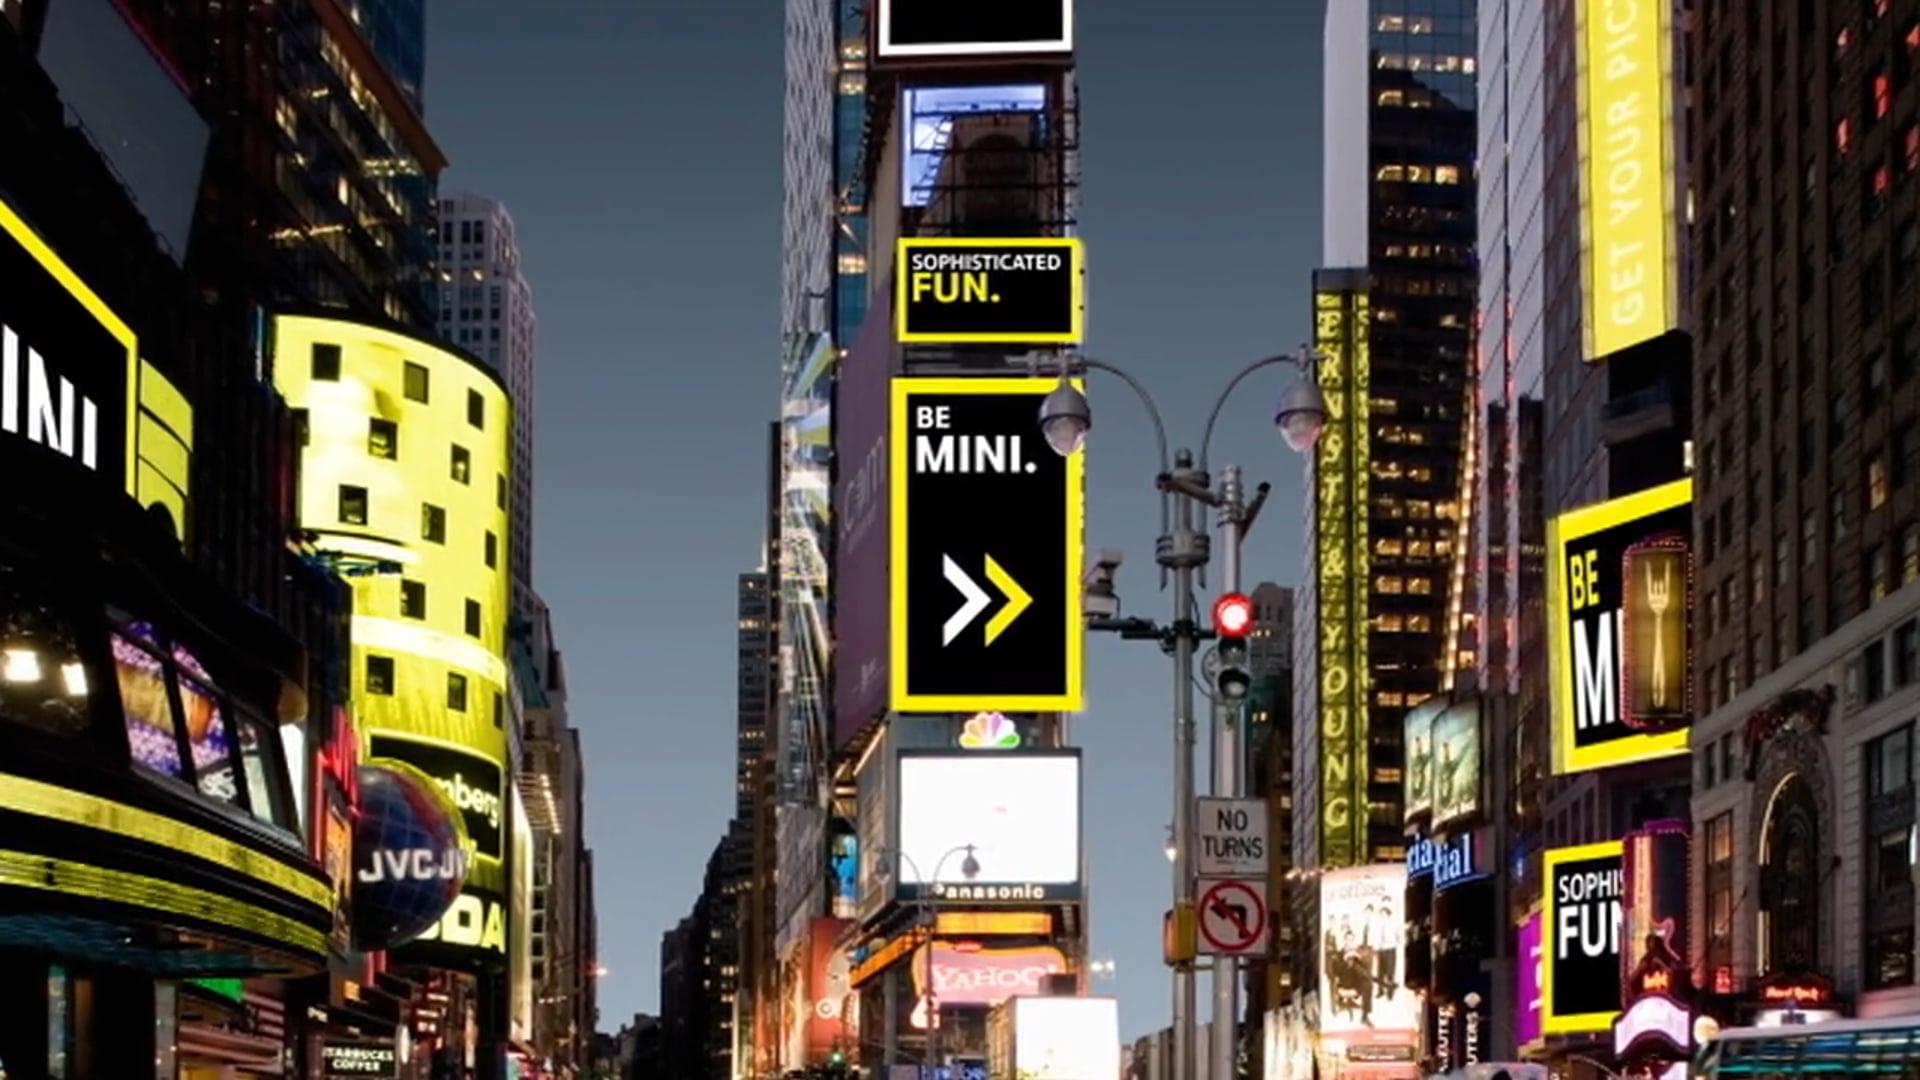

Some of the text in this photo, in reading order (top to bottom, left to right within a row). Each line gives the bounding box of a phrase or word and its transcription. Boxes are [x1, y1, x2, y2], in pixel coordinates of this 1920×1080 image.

[1605, 91, 1643, 226] YOUR
[911, 254, 1062, 272] SOPHISTICATED
[911, 272, 1001, 304] FUN.
[1611, 241, 1645, 326] GET
[916, 406, 951, 429] BE
[915, 435, 1038, 474] MINI.
[1569, 549, 1600, 611] BE
[1322, 624, 1348, 828] YOUNG
[1217, 809, 1249, 832] NO
[1202, 835, 1263, 860] TURNS
[358, 848, 434, 882] JVC
